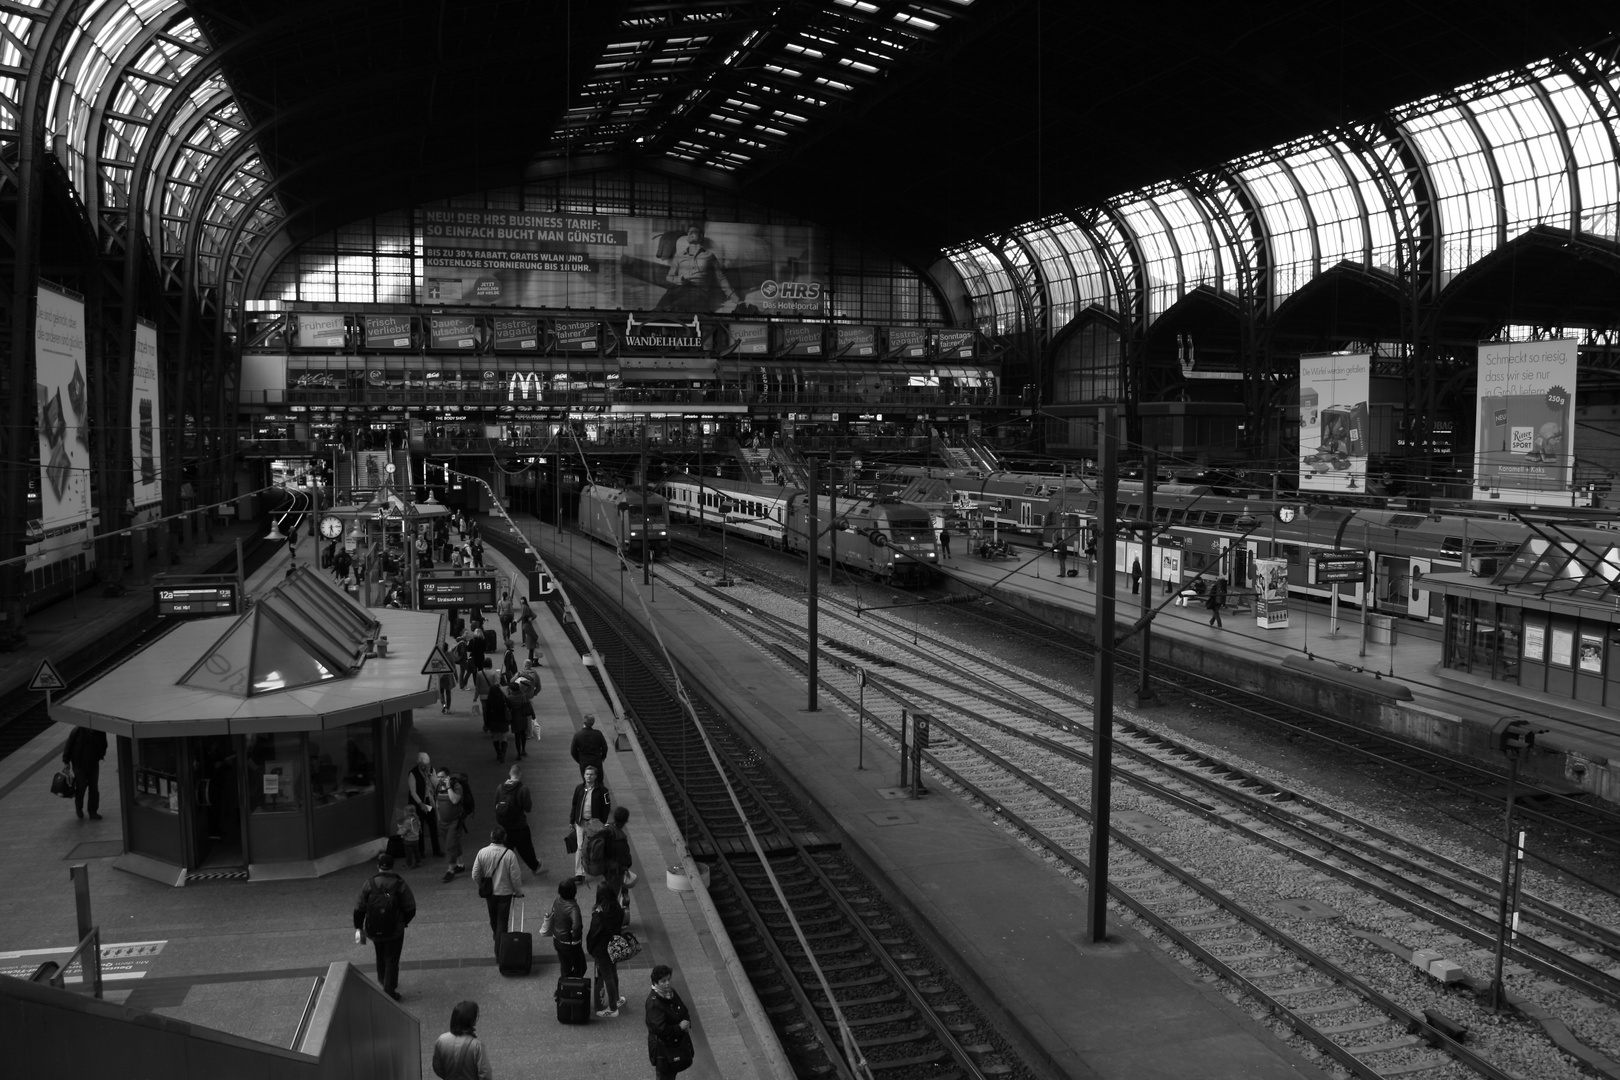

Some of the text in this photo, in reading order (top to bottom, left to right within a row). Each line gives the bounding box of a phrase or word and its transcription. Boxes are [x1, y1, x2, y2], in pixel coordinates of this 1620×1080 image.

[427, 212, 600, 230] NEU! DER HRS BUSINESS TARIF:
[427, 225, 617, 244] SO EINFACH BUCHT MAN GÜNSTIG.
[475, 251, 508, 260] RABATT,
[510, 252, 539, 260] GRATIS
[541, 254, 564, 262] WLAN
[427, 258, 481, 268] KOSTENLOSE
[484, 260, 542, 270] STORNIERUNG
[544, 262, 558, 271] BIS
[781, 282, 820, 299] HRS
[778, 302, 818, 310] Hotelportal
[300, 319, 342, 330] Frühreif?
[367, 318, 396, 327] Frisch
[432, 320, 462, 328] Dauer-
[496, 320, 530, 330] Esstra-
[556, 322, 596, 331] Sonntags-
[368, 324, 410, 335] verliebt?
[433, 325, 474, 336] lutscher?
[497, 325, 536, 337] vagant?
[558, 329, 586, 338] fahrer?
[732, 328, 767, 337] Frühreif?
[785, 327, 809, 336] Frisch
[626, 336, 701, 347] WANDELHALLE
[786, 333, 820, 343] verliebt?
[1486, 350, 1568, 366] Schmeckt so riesig,
[1328, 366, 1345, 374] werden
[1485, 370, 1550, 382] dass wir sie nur
[1494, 386, 1516, 397] Groß
[1513, 430, 1532, 443] Ritter
[538, 573, 554, 594] D
[159, 591, 173, 599] 12a
